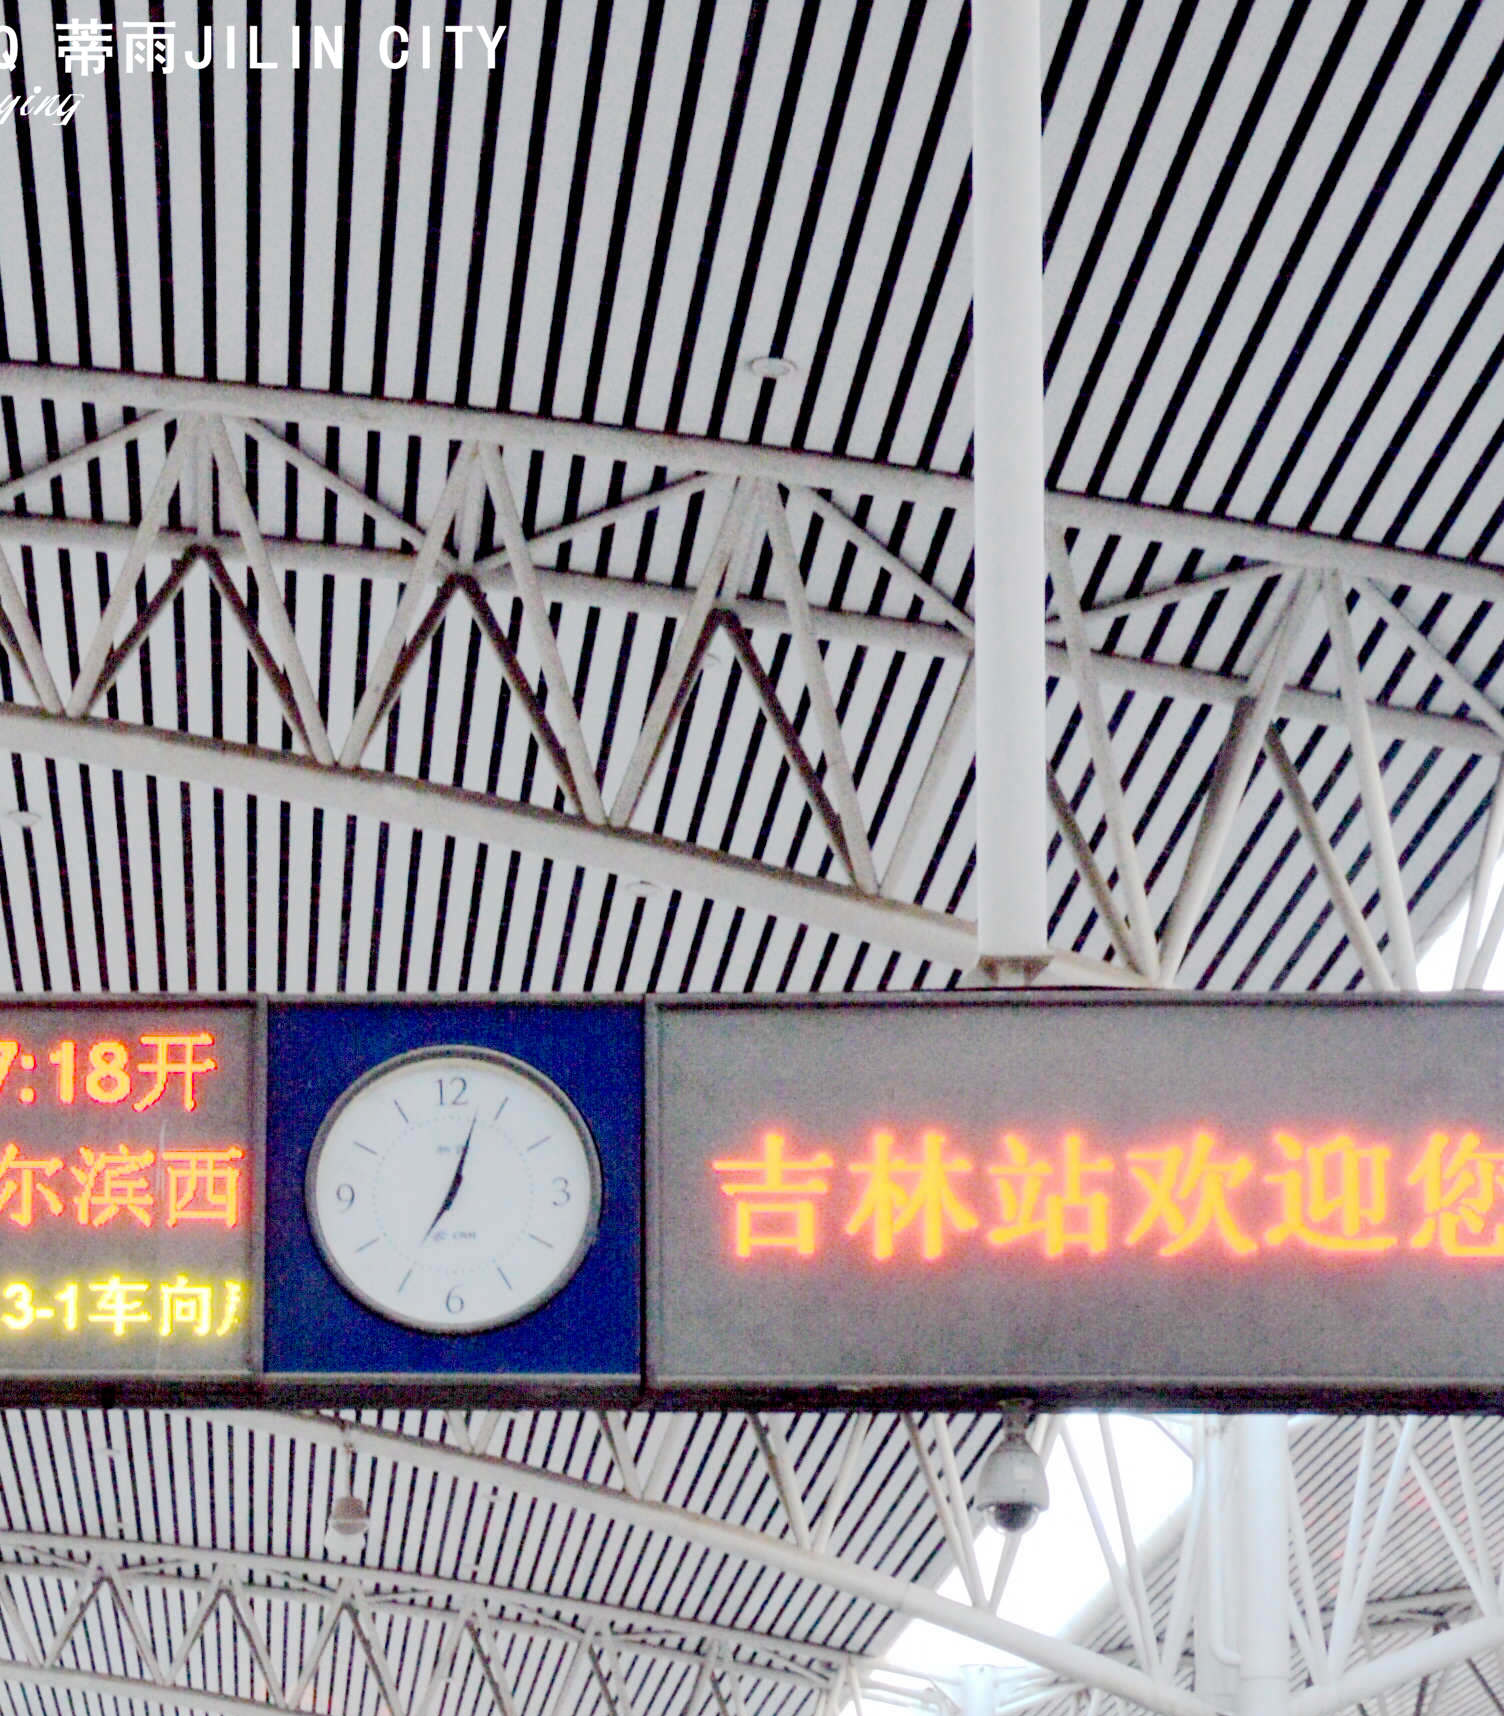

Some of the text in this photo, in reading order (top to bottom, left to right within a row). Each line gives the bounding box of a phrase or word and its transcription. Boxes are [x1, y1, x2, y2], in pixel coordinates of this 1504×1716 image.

[435, 1076, 469, 1107] 12
[334, 1183, 356, 1214] 9
[550, 1176, 572, 1208] 3
[444, 1286, 466, 1314] 6
